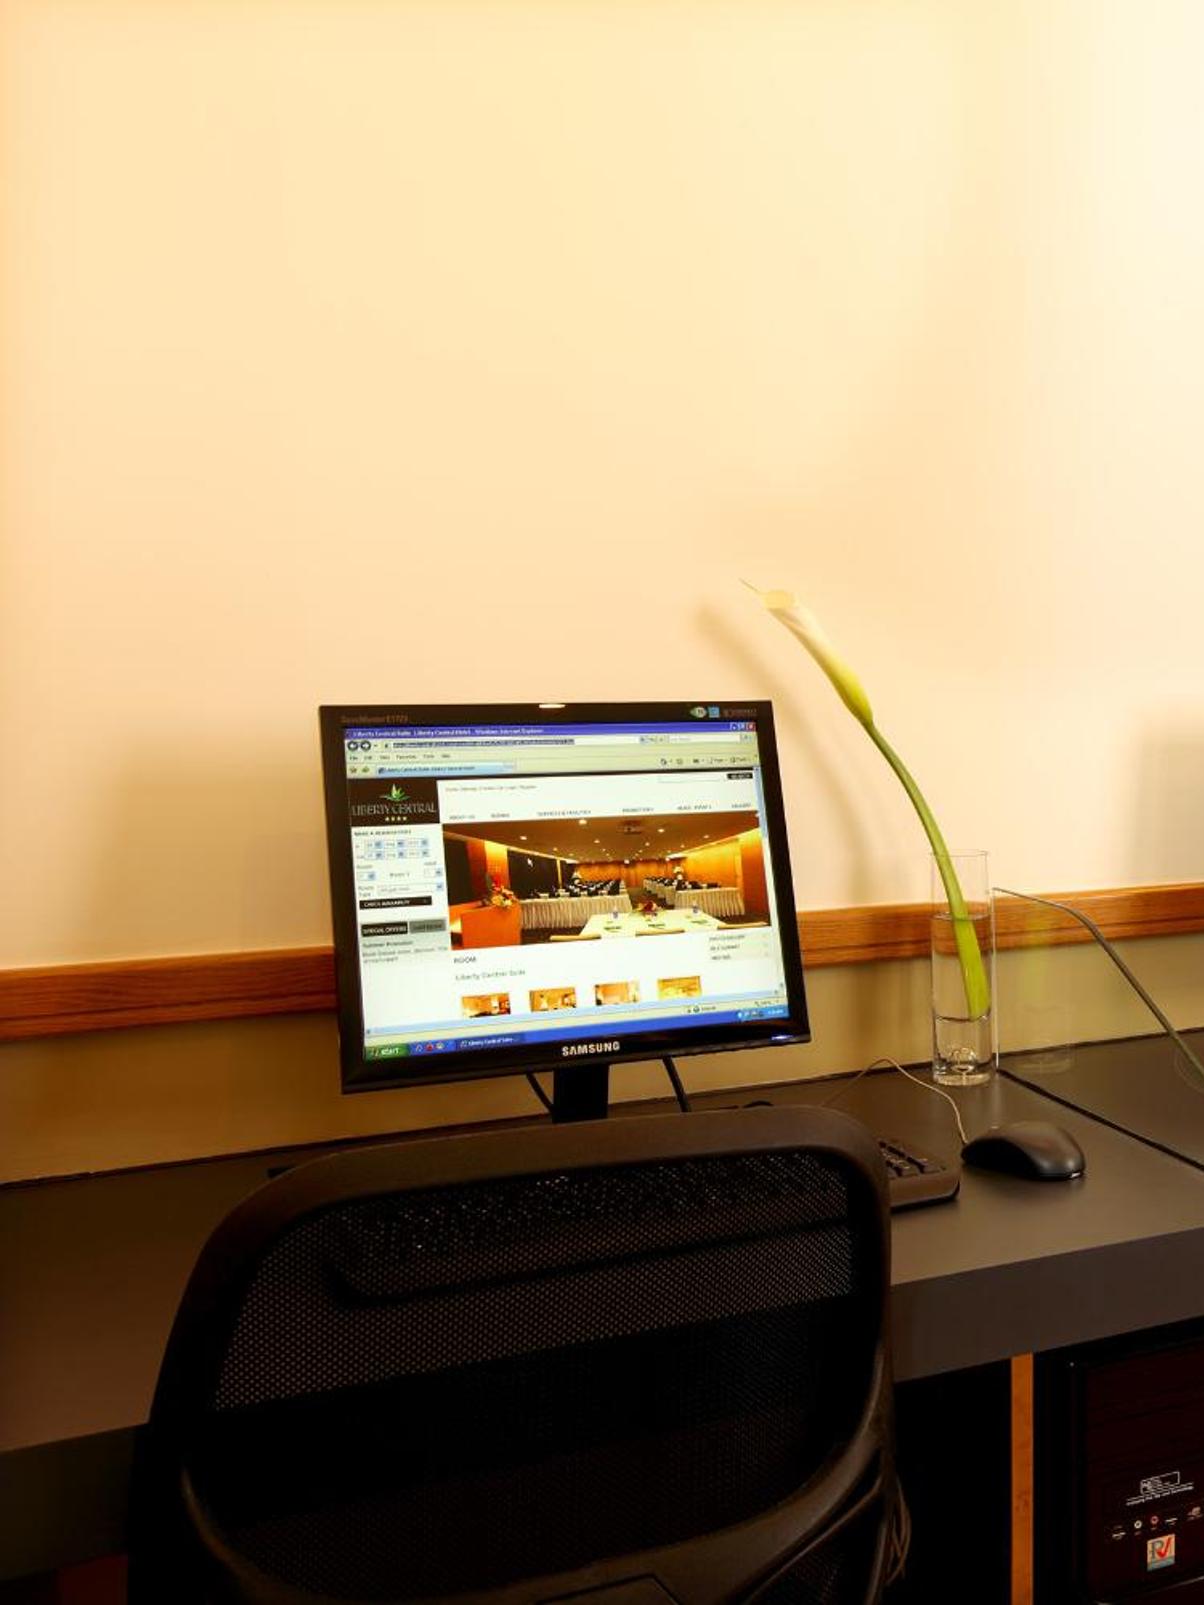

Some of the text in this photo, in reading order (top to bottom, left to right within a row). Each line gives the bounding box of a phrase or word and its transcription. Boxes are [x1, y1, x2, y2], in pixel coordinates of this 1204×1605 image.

[352, 802, 436, 816] LIBERTY CENTRAL
[562, 1040, 620, 1057] SAMSUNG
